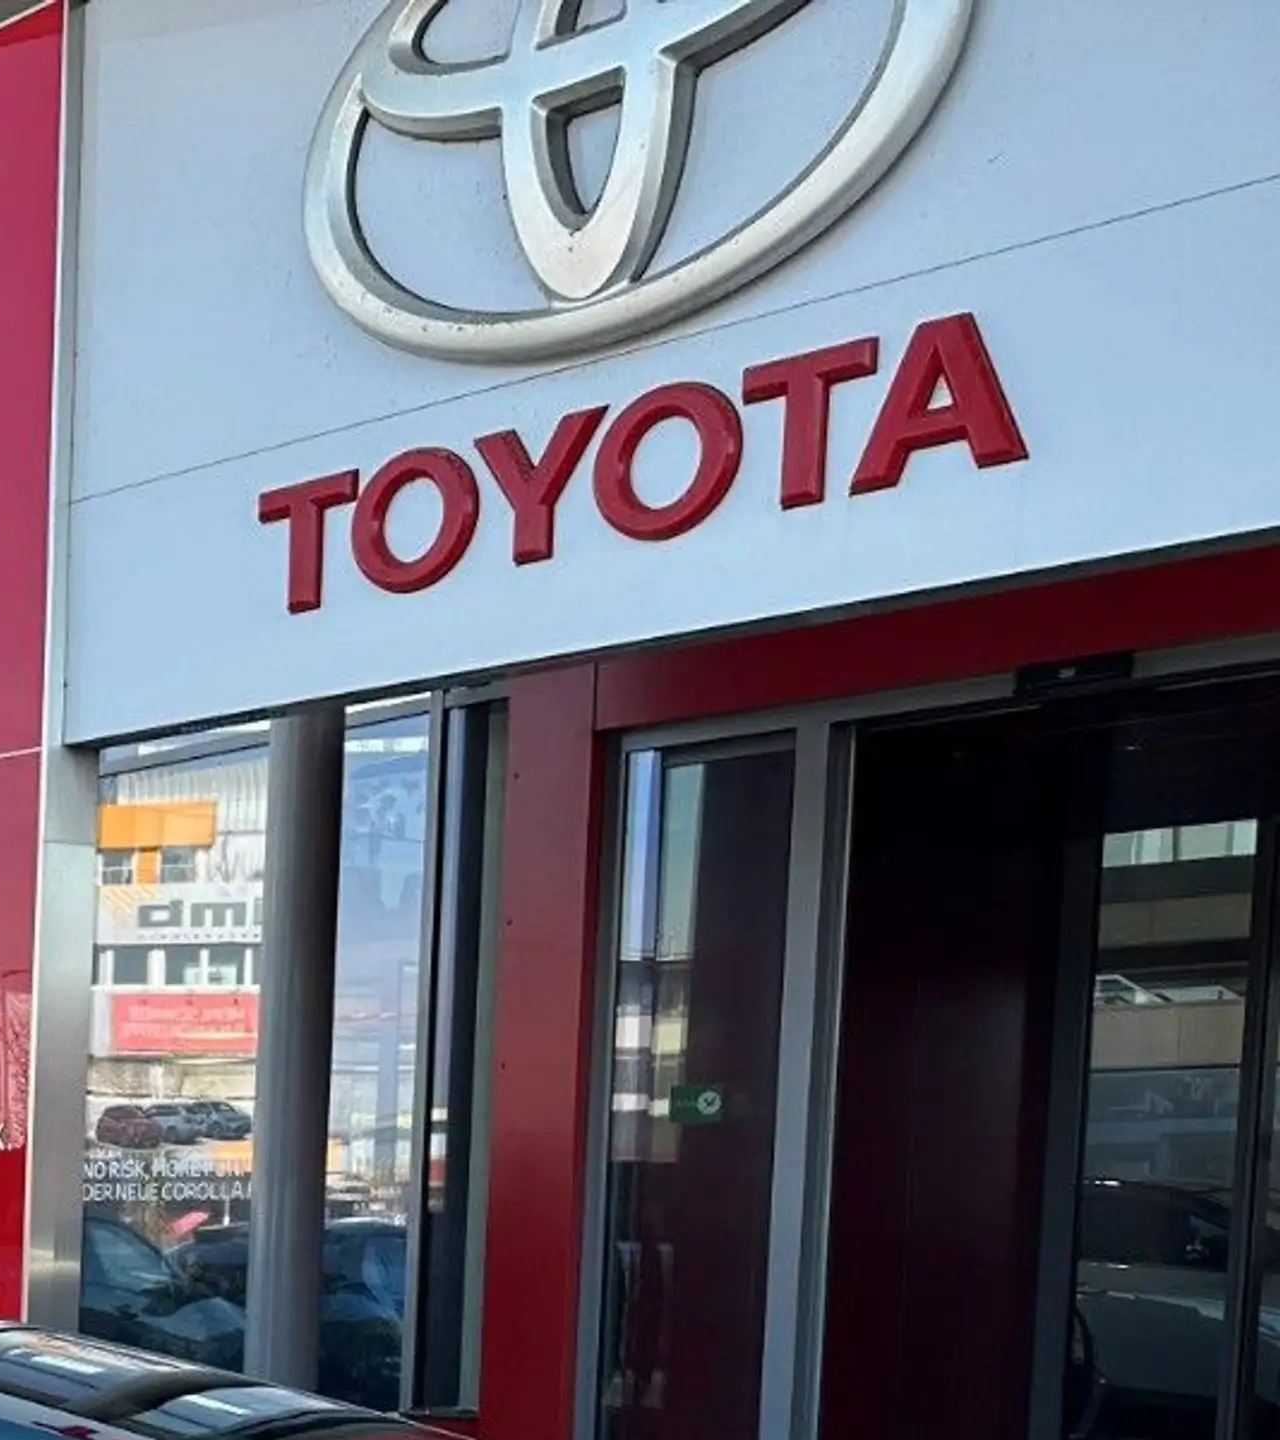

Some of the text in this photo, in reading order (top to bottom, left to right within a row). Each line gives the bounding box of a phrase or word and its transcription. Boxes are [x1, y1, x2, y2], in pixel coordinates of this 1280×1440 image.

[258, 311, 1030, 615] TOYOTA
[83, 1161, 107, 1180] NO
[83, 1184, 114, 1201] DER
[115, 1183, 158, 1201] NEUE
[161, 1180, 244, 1201] COROLLA
